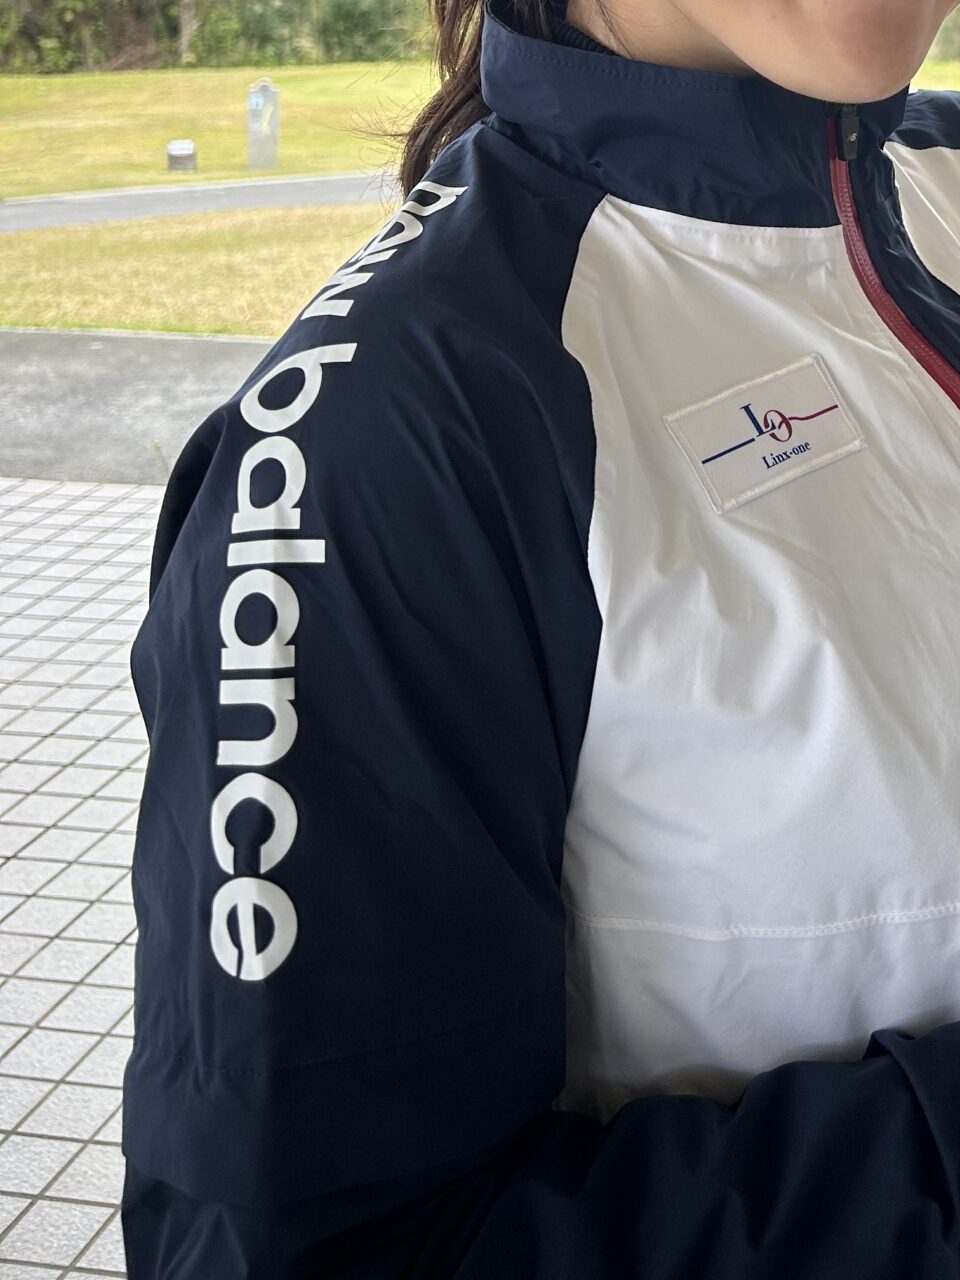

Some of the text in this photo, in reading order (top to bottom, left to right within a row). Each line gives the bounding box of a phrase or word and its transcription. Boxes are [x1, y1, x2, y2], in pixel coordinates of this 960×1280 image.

[210, 181, 469, 982] new balance
[762, 440, 812, 469] Linx-one
